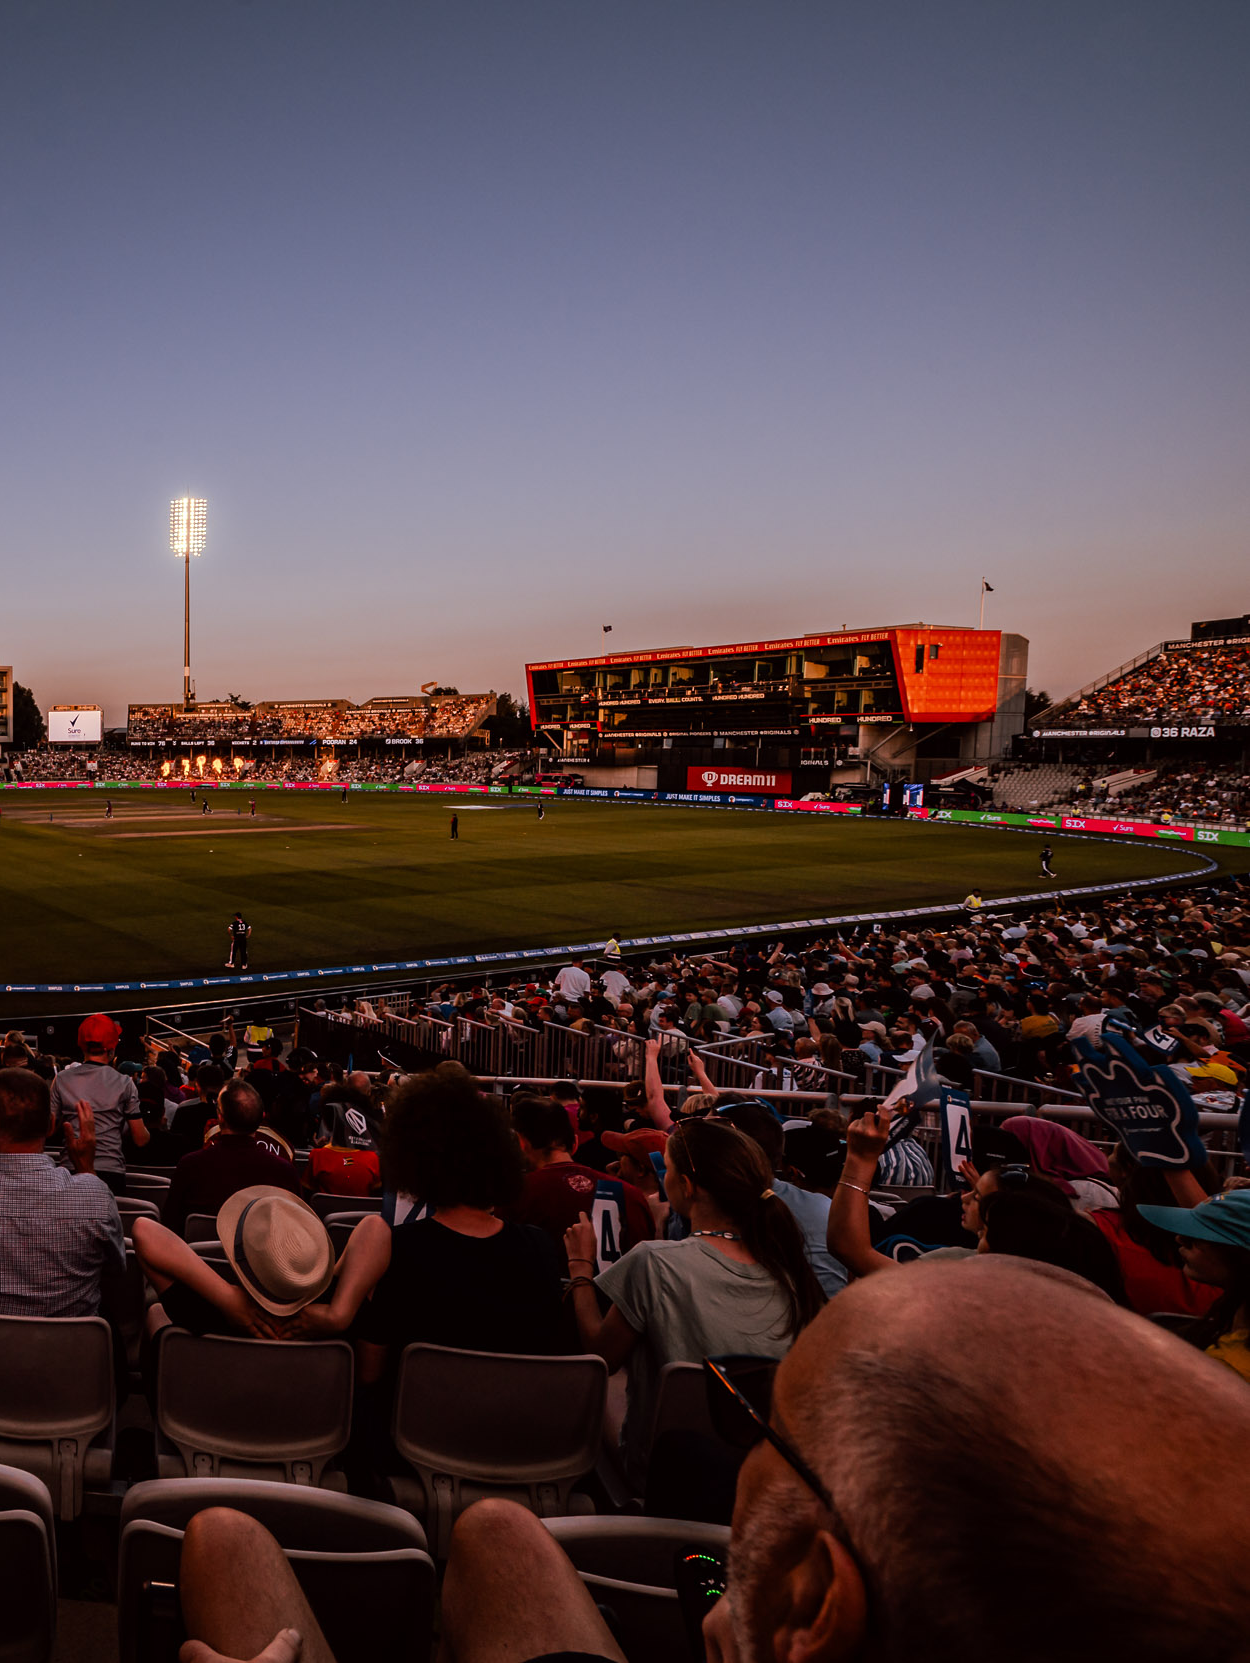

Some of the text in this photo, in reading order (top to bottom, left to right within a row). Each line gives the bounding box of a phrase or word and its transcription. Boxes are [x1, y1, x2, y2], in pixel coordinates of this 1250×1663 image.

[803, 638, 820, 646] BETTER
[827, 635, 859, 644] Emirates
[870, 632, 889, 640] BETTER
[1167, 639, 1225, 650] MANCHESTER
[688, 649, 702, 657] BETTER
[1162, 726, 1216, 738] 36 RAZA
[719, 773, 777, 787] DREAM11
[699, 795, 721, 803] SIMPLES
[1065, 819, 1086, 829] SIX
[1119, 824, 1134, 832] Sure
[1197, 831, 1219, 841] SIX
[237, 923, 246, 931] 13
[1152, 1029, 1170, 1044] 4
[1128, 1104, 1170, 1120] FOUR
[955, 1114, 972, 1163] 4
[601, 1210, 621, 1263] 4
